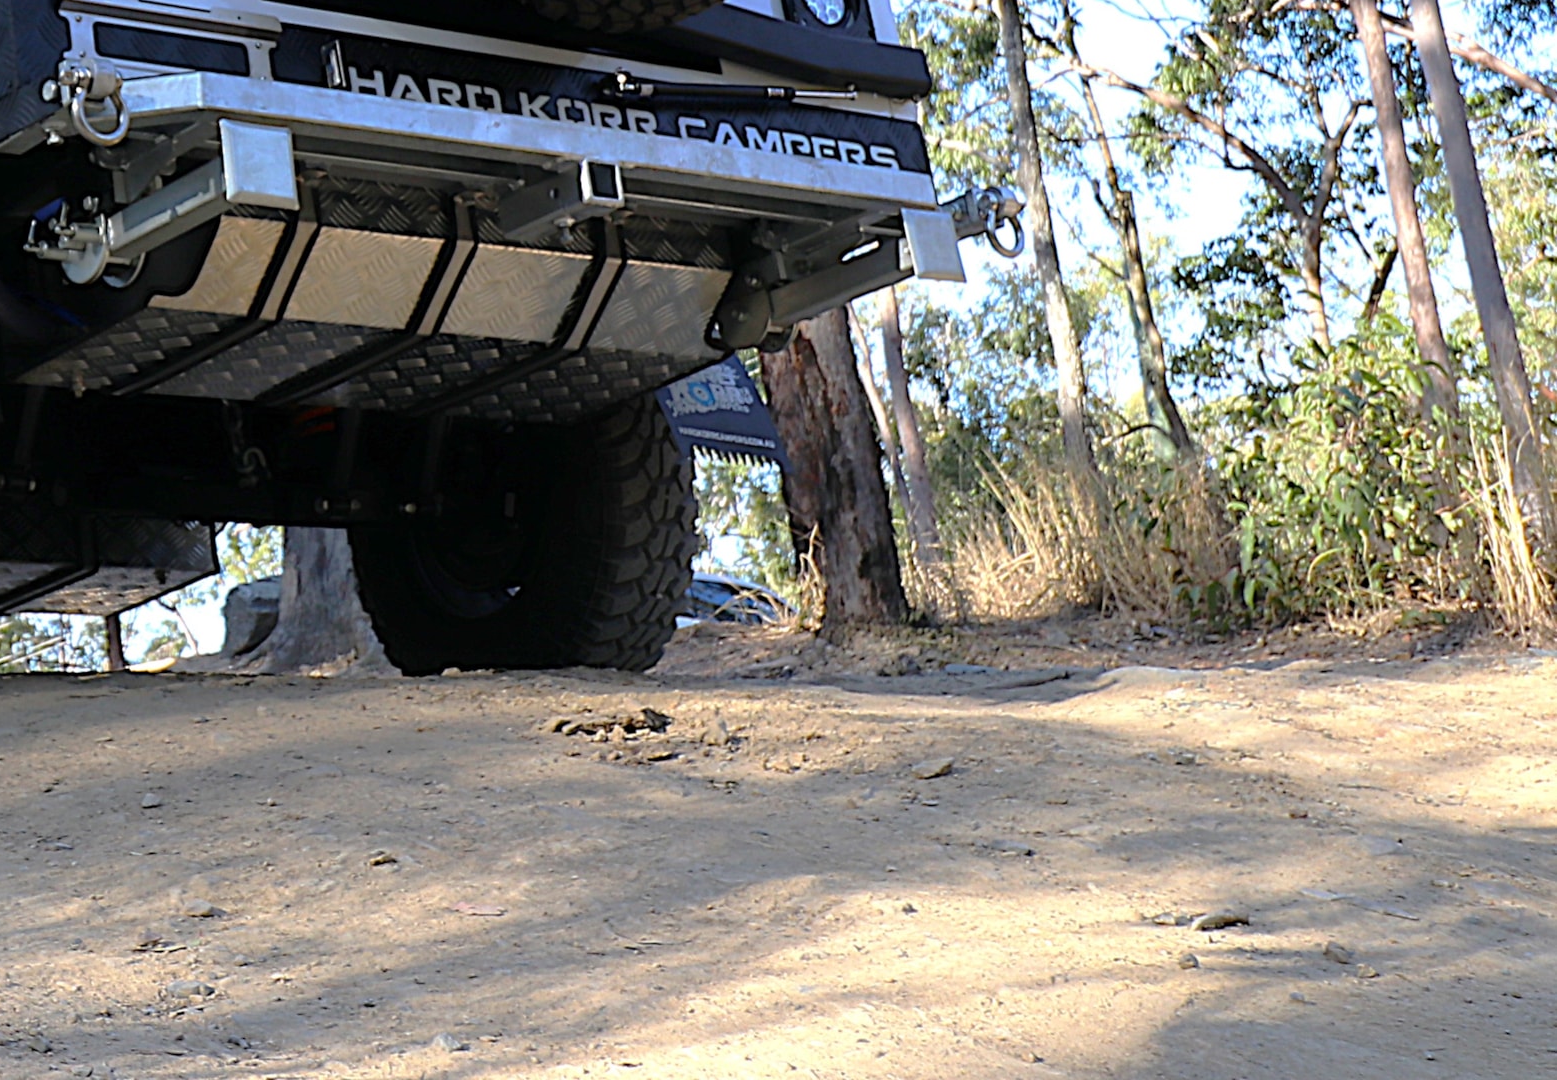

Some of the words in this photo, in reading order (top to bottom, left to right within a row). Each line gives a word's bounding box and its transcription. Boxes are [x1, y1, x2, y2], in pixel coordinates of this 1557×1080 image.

[348, 66, 504, 114] HARD
[518, 91, 657, 135] KORR
[677, 115, 900, 171] CAMPERS
